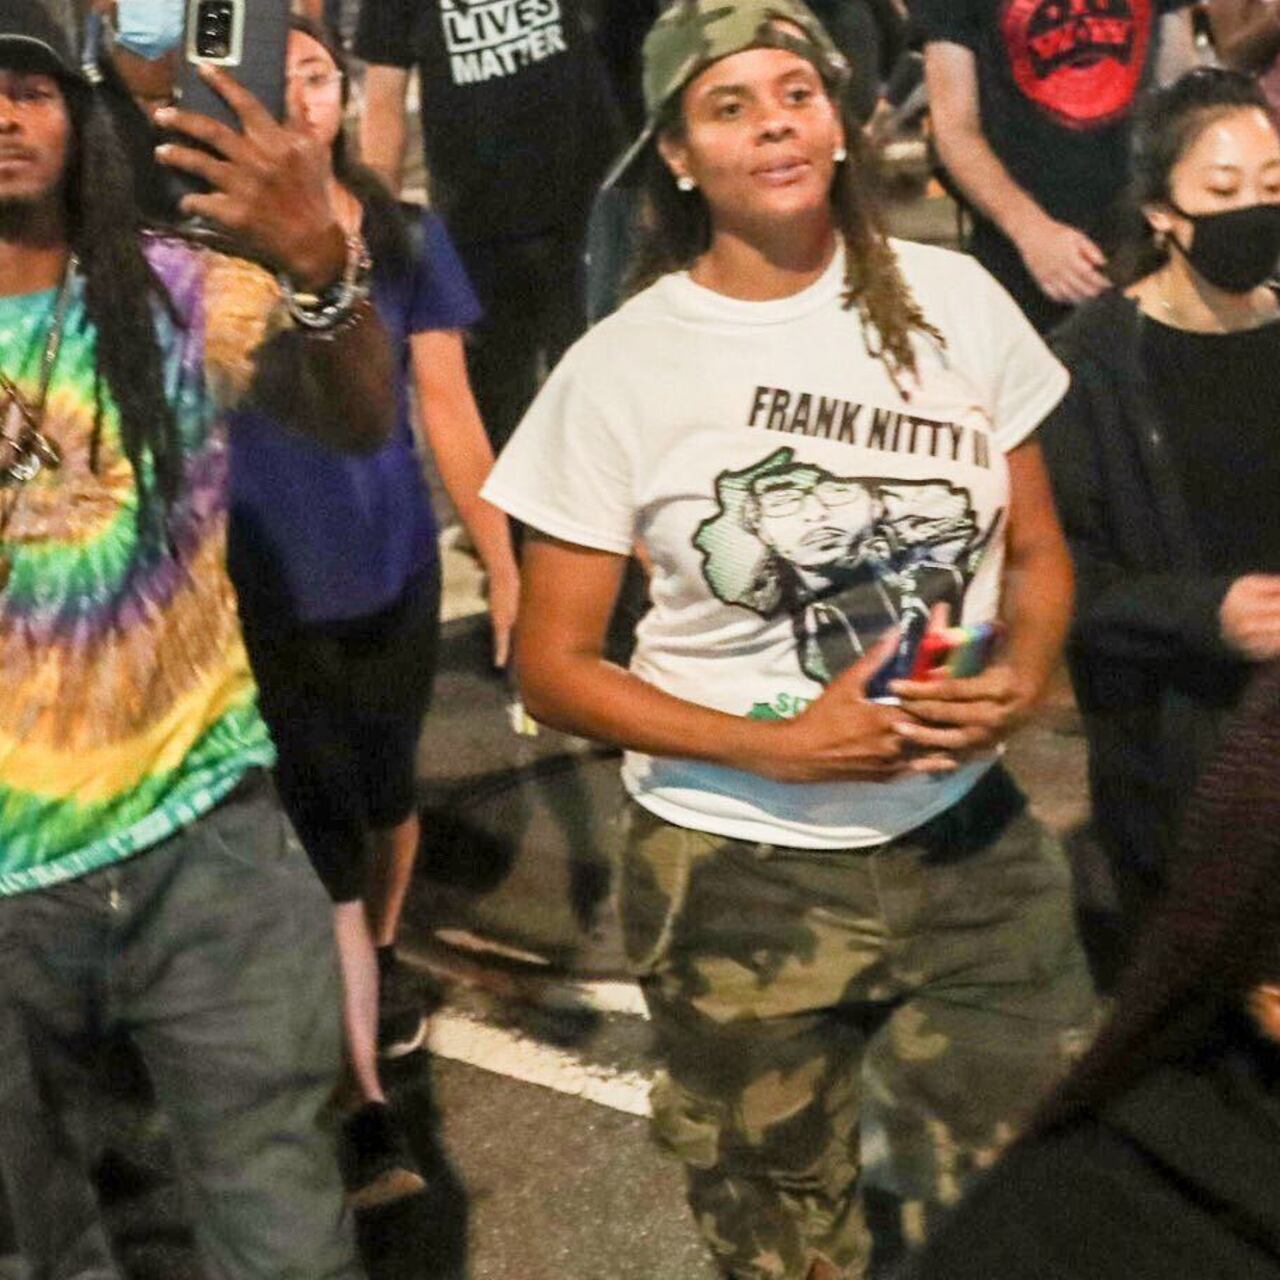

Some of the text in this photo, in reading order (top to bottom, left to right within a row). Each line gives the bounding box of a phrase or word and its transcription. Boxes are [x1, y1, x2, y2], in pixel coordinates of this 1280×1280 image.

[450, 23, 568, 86] MATTER
[746, 385, 863, 446] FRANK
[866, 407, 965, 462] NITTY
